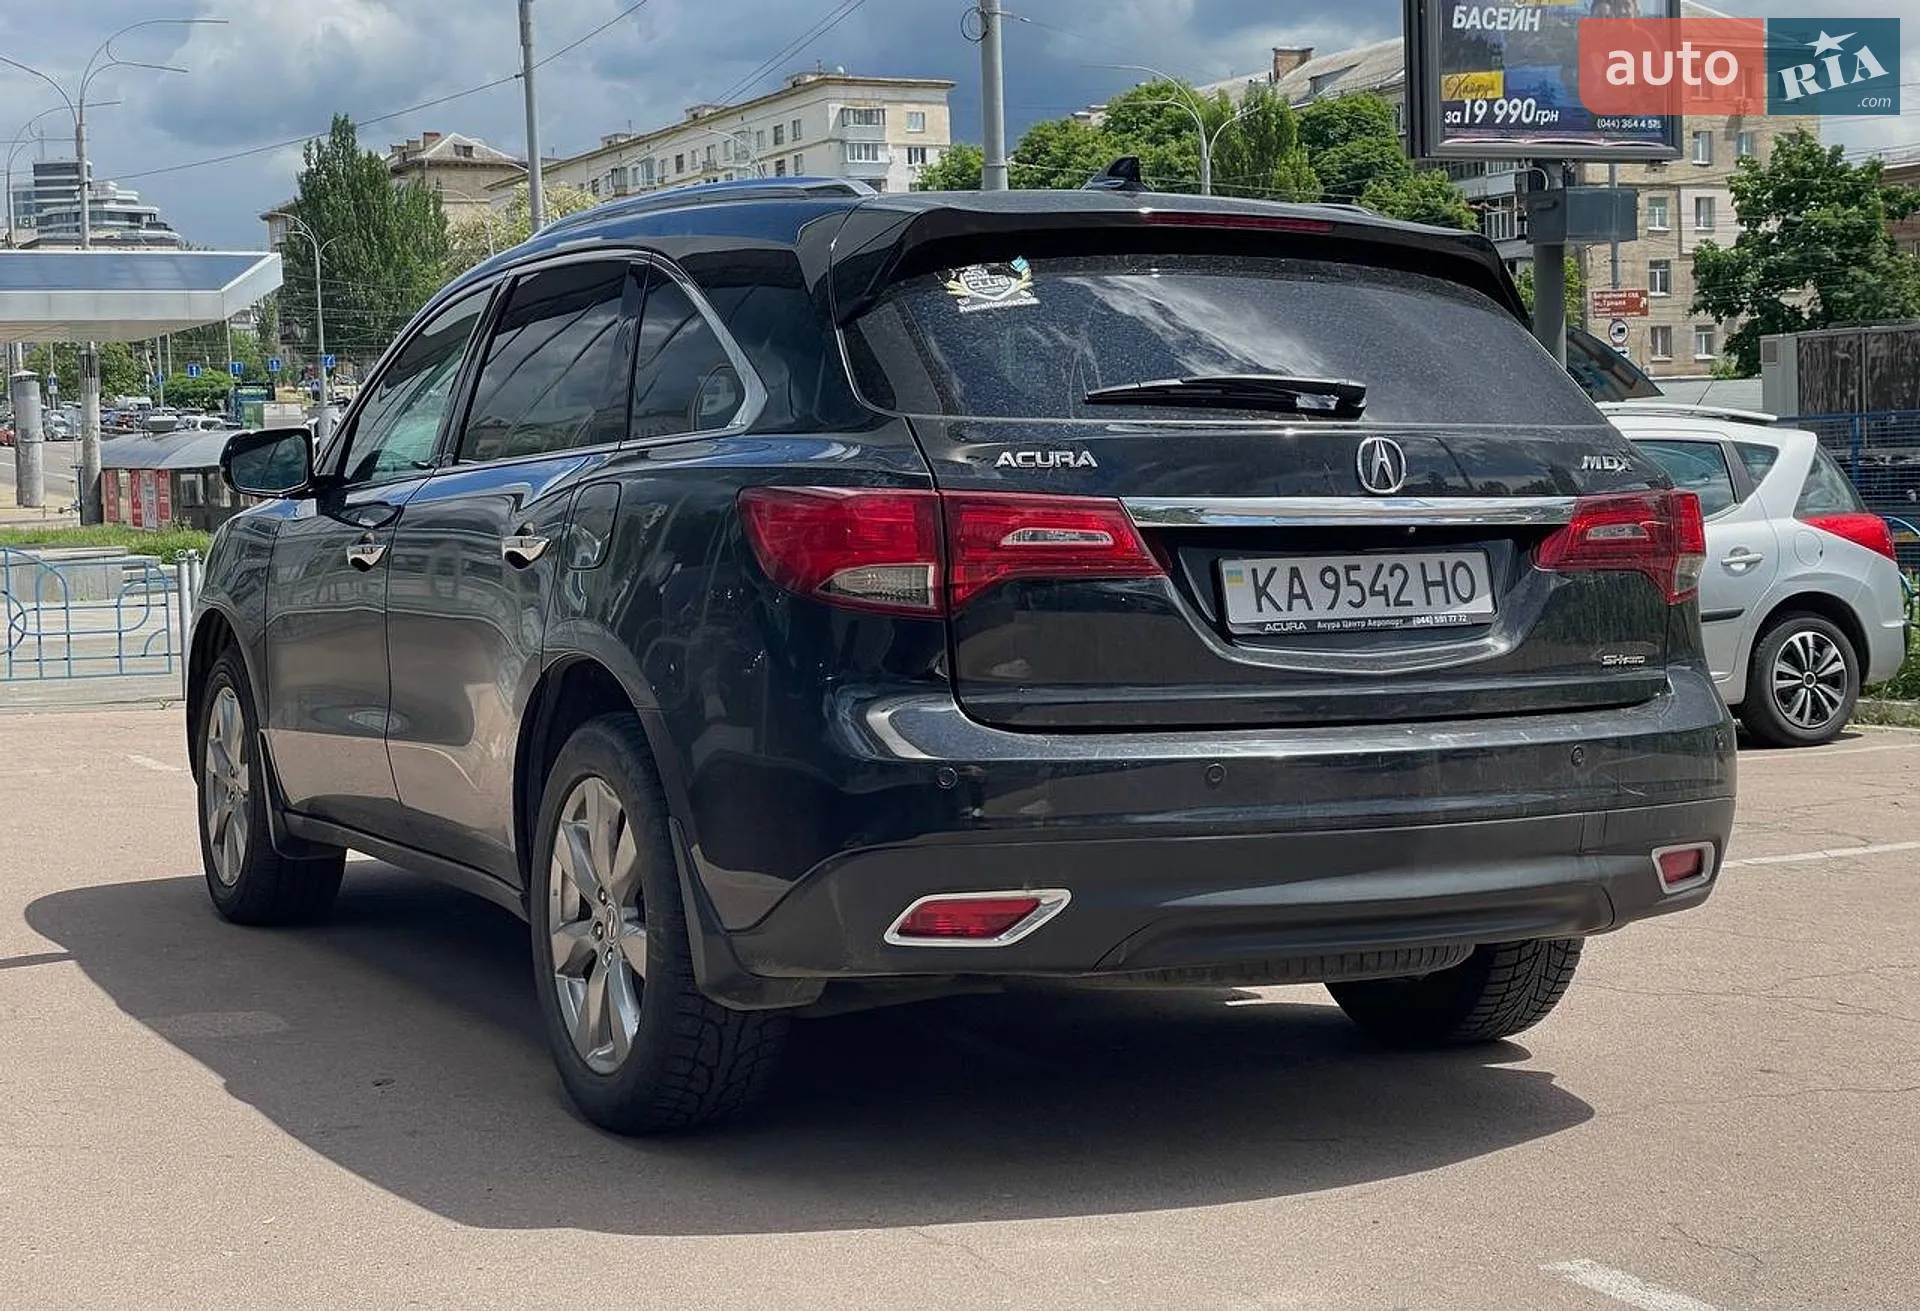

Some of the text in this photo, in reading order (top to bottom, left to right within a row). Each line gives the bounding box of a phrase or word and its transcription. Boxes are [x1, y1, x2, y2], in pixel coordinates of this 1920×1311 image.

[1452, 3, 1541, 31] БАСЕЙН
[994, 450, 1098, 468] ACURA
[1581, 455, 1632, 472] MDX
[1319, 561, 1414, 611] 9542
[1264, 621, 1307, 632] ACURA
